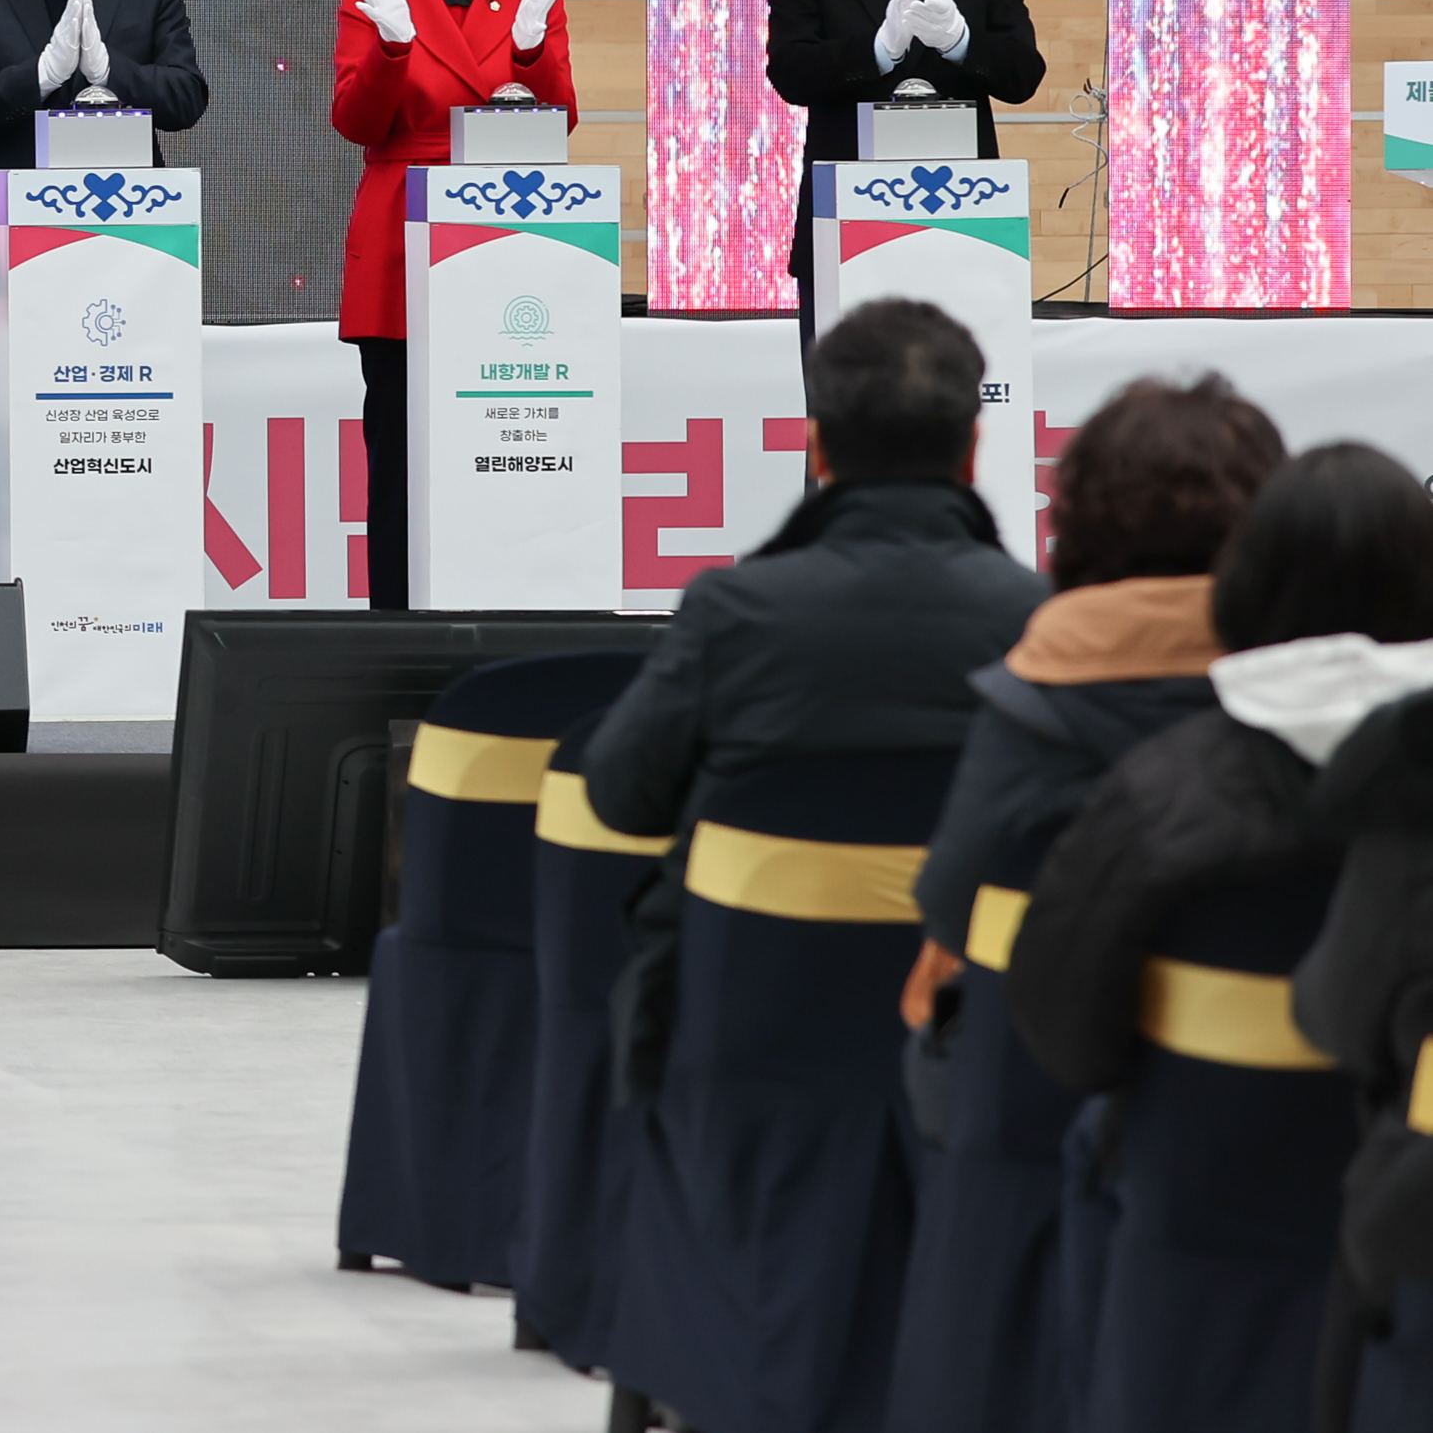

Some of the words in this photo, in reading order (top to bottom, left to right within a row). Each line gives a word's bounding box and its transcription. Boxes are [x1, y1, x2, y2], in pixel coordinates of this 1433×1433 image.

[139, 365, 153, 382] R
[480, 363, 550, 381] 내항개발
[555, 363, 569, 380] R
[981, 382, 1010, 404] 포!
[45, 409, 81, 422] 신성장
[84, 409, 108, 422] 산업
[112, 408, 160, 422] 육성으로
[484, 407, 520, 420] 새로운
[524, 407, 560, 420] 가치를
[59, 431, 107, 444] 일자리가
[110, 431, 147, 444] 풍부한
[500, 429, 548, 442] 창출하는
[53, 457, 153, 475] 산업혁신도시
[474, 455, 574, 473] 열린해양도시
